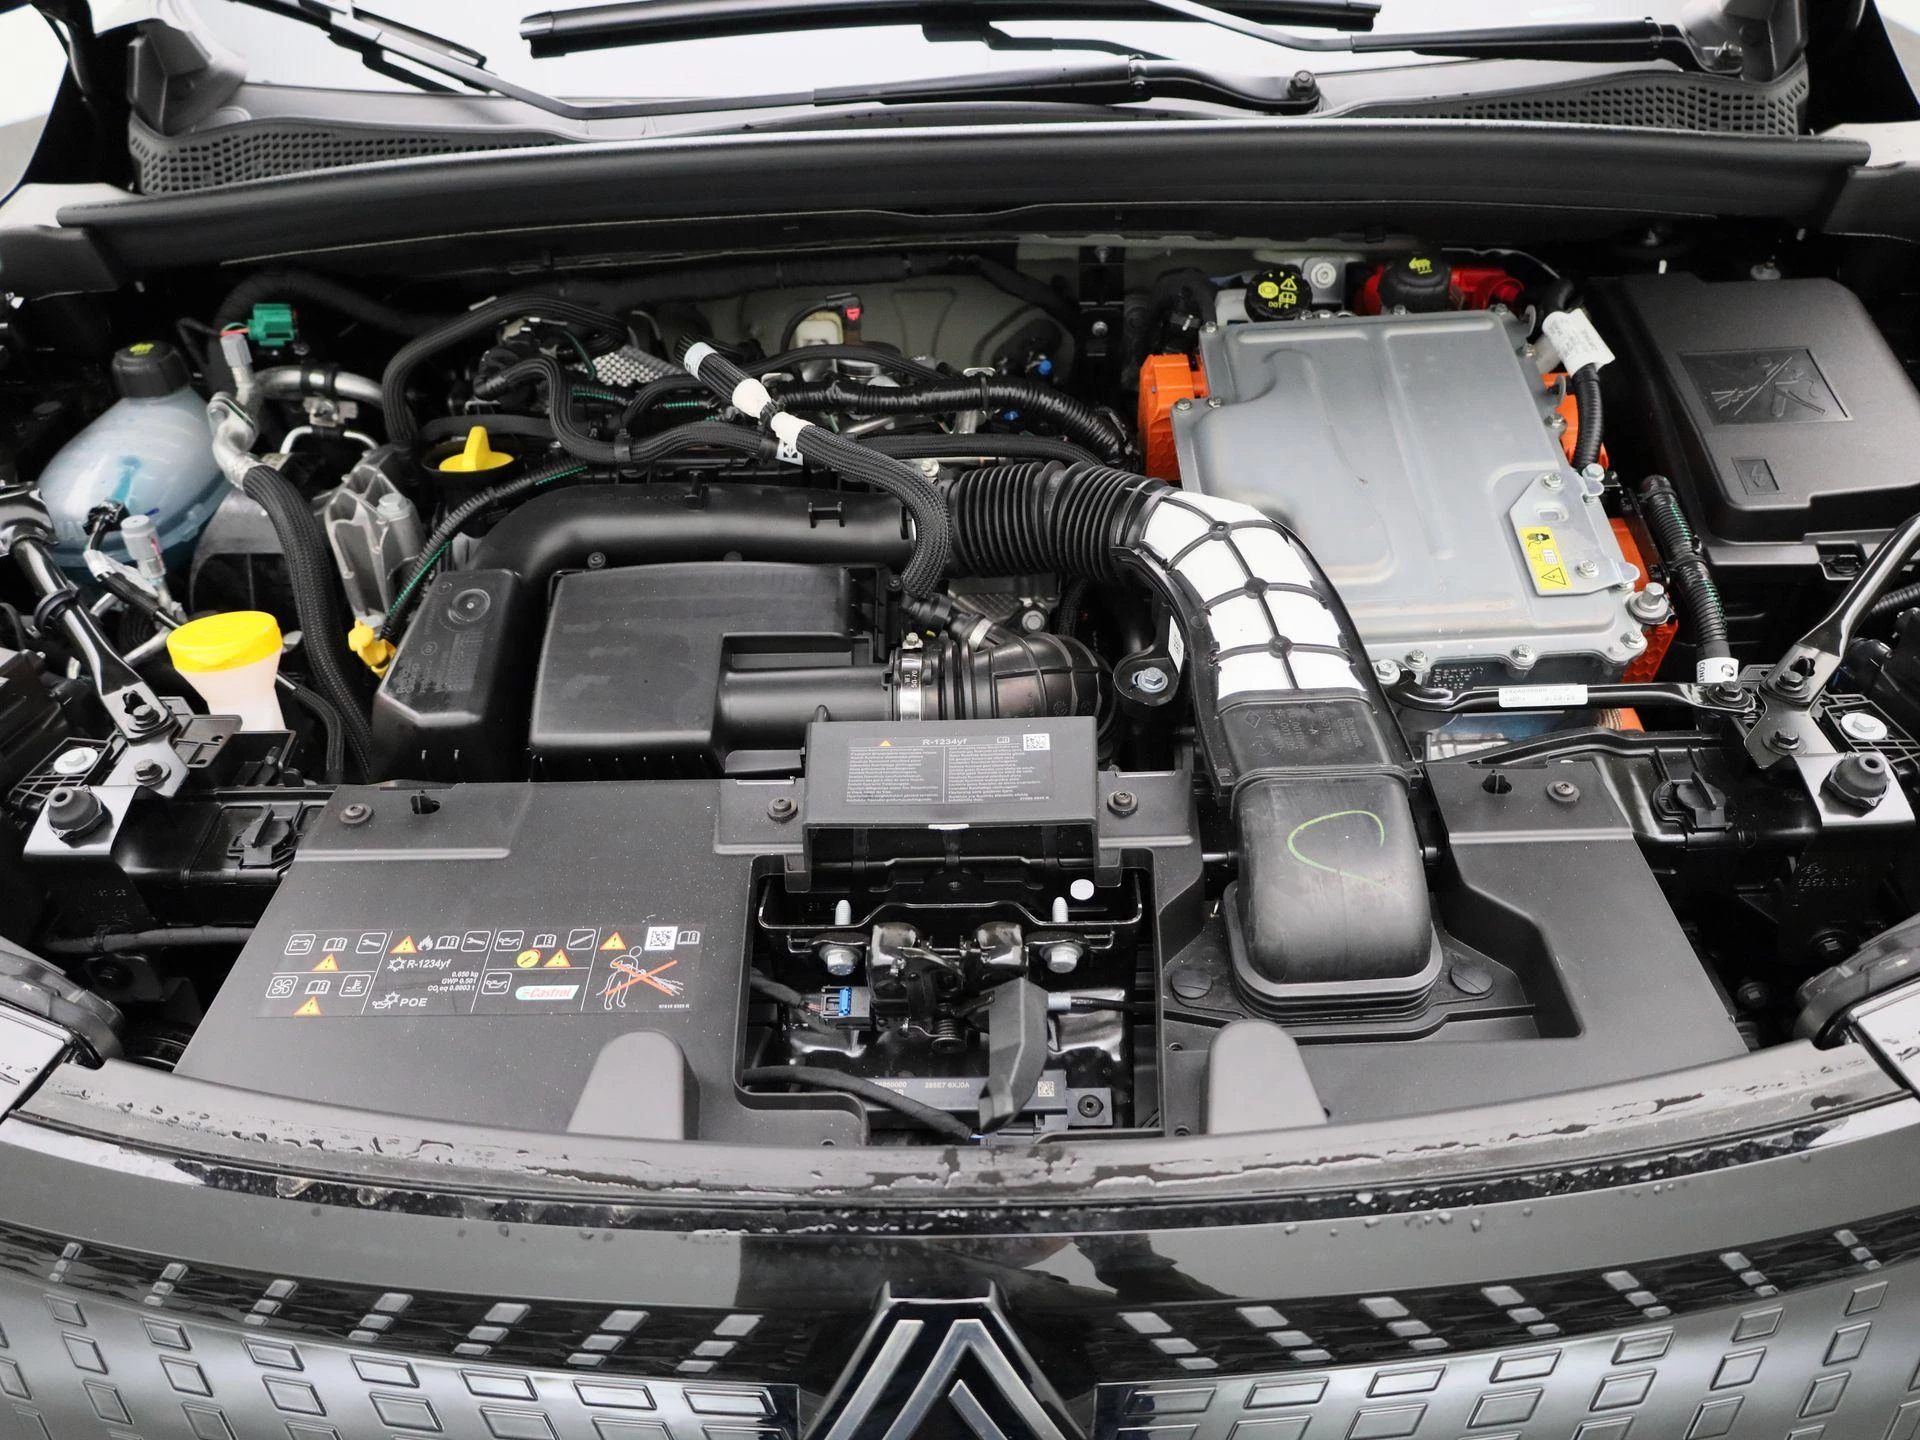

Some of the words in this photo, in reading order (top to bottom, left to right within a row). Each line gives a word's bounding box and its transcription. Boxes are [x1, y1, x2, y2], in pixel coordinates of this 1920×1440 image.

[1268, 301, 1282, 309] DOT
[922, 738, 967, 746] R-1234yf
[406, 959, 452, 970] R-1234yf
[528, 987, 573, 999] Castrol
[399, 998, 428, 1007] POE
